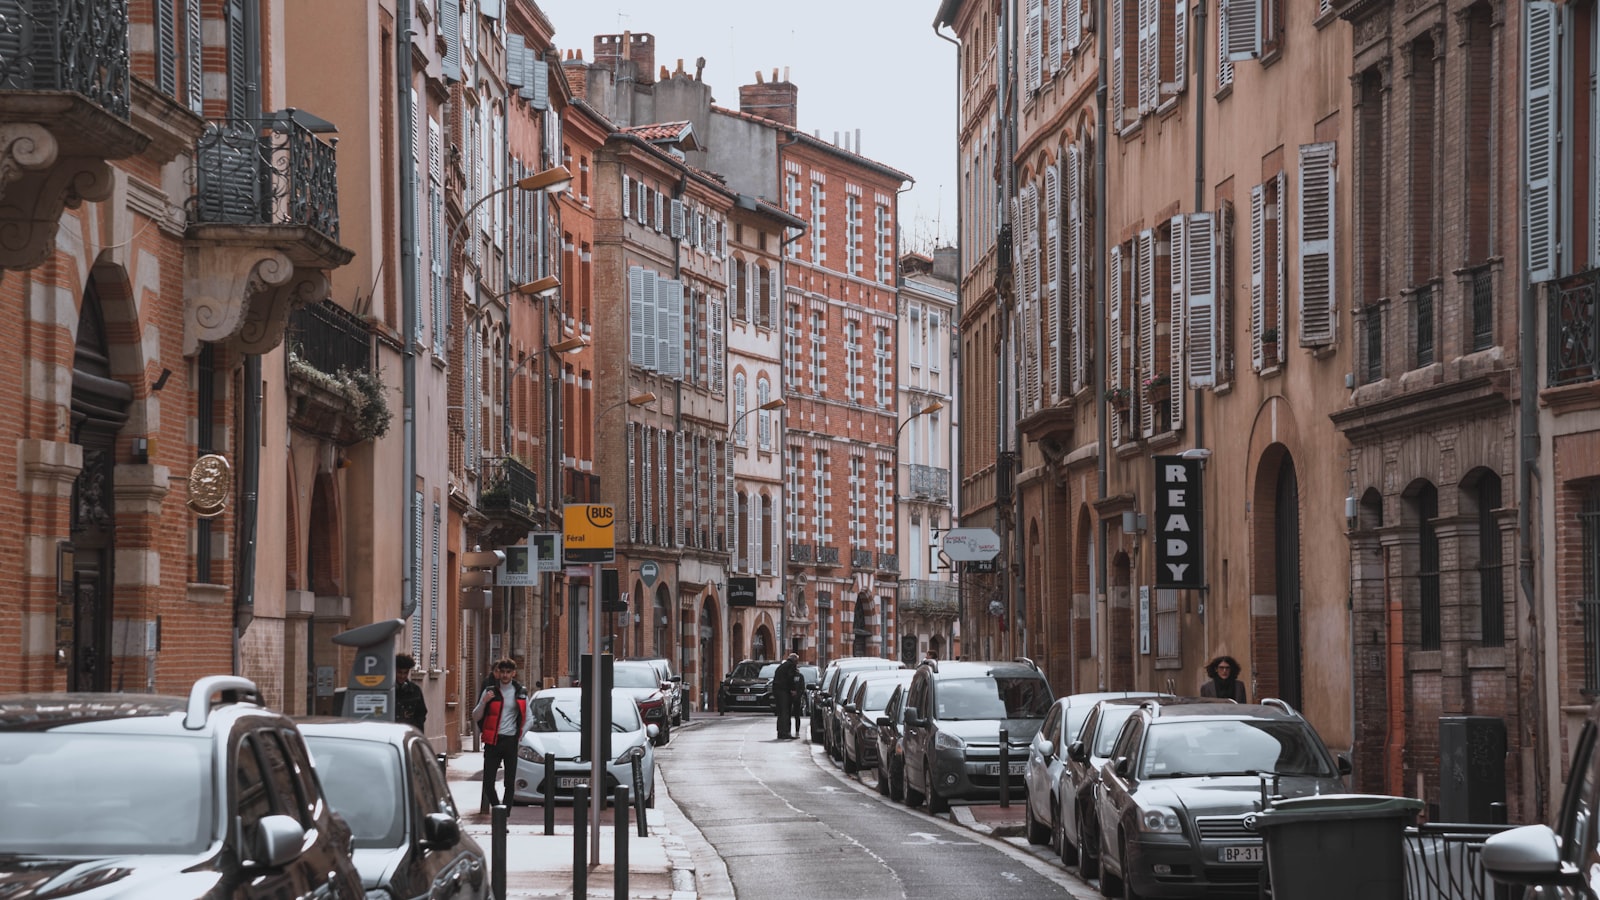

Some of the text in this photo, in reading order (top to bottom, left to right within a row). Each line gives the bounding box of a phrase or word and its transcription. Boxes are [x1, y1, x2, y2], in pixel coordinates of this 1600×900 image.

[591, 507, 613, 518] BUS
[1164, 464, 1191, 581] READY
[566, 534, 585, 542] Féral
[364, 656, 378, 674] P
